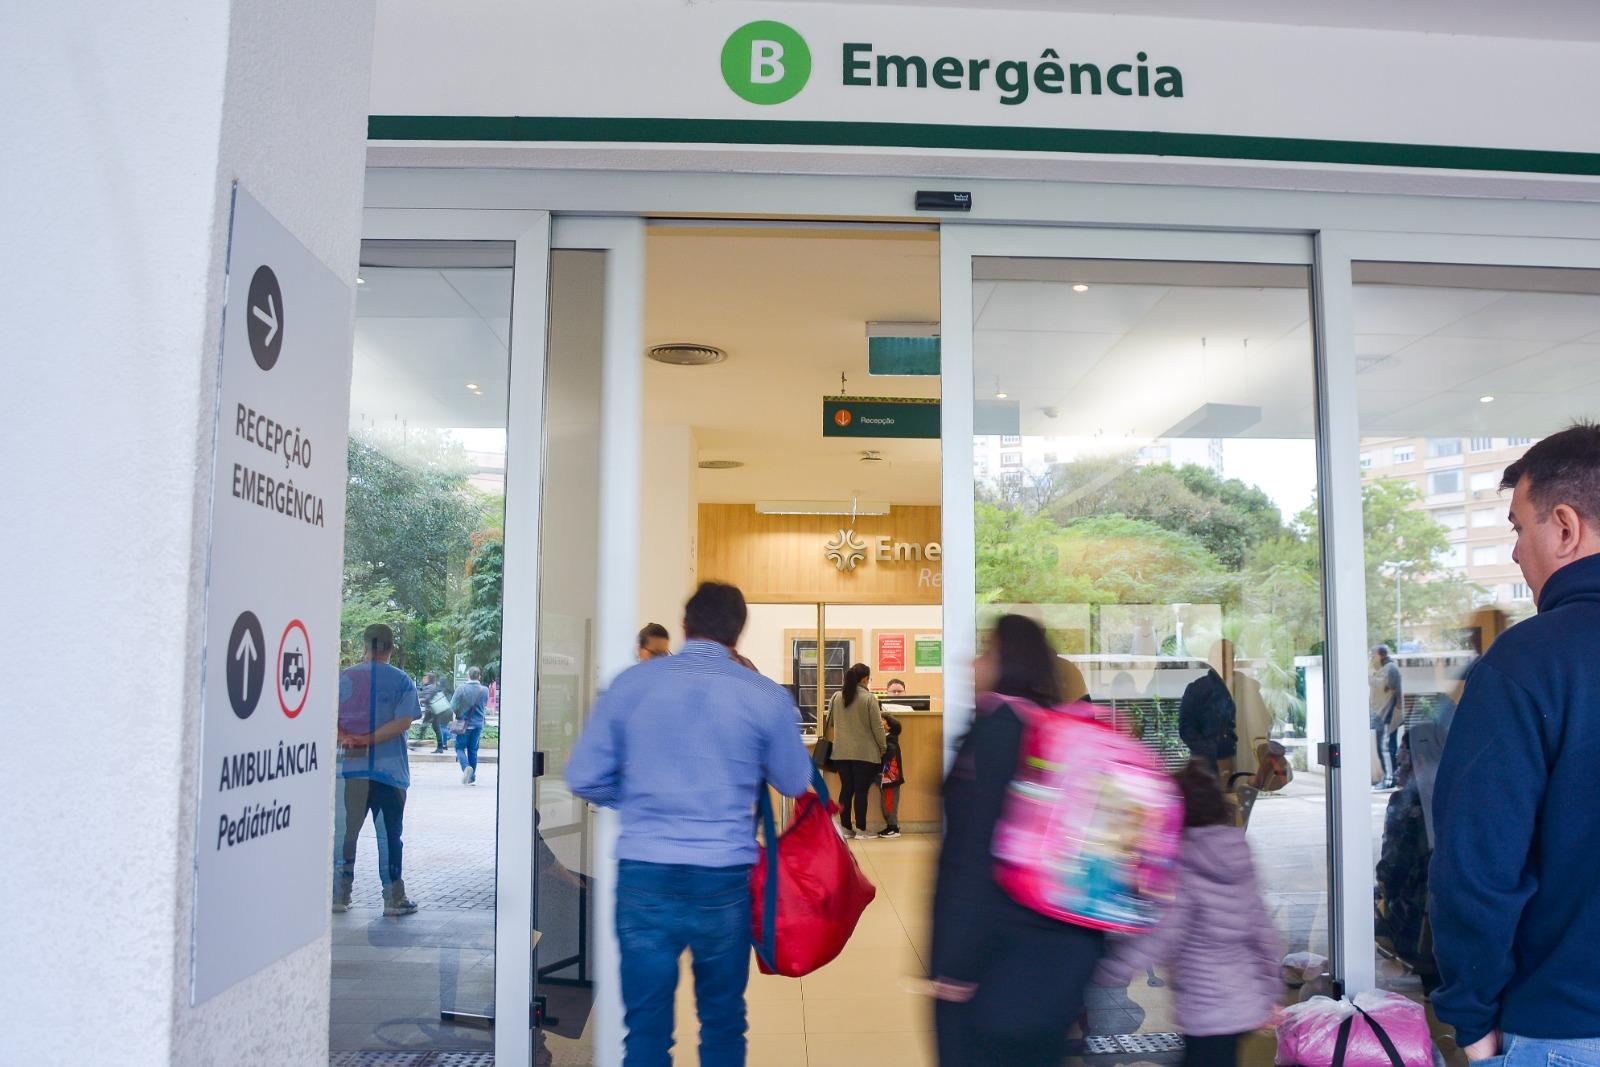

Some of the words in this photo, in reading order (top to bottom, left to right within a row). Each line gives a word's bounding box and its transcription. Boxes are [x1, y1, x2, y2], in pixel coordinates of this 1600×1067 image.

[750, 39, 786, 84] B
[842, 42, 1185, 105] Emergência
[236, 402, 312, 469] RECEPÇÃO
[860, 416, 895, 426] Recepção
[232, 463, 325, 528] EMERGÊNCIA
[219, 739, 318, 793] AMBULÂNCIA
[217, 799, 291, 852] Pediátrica
